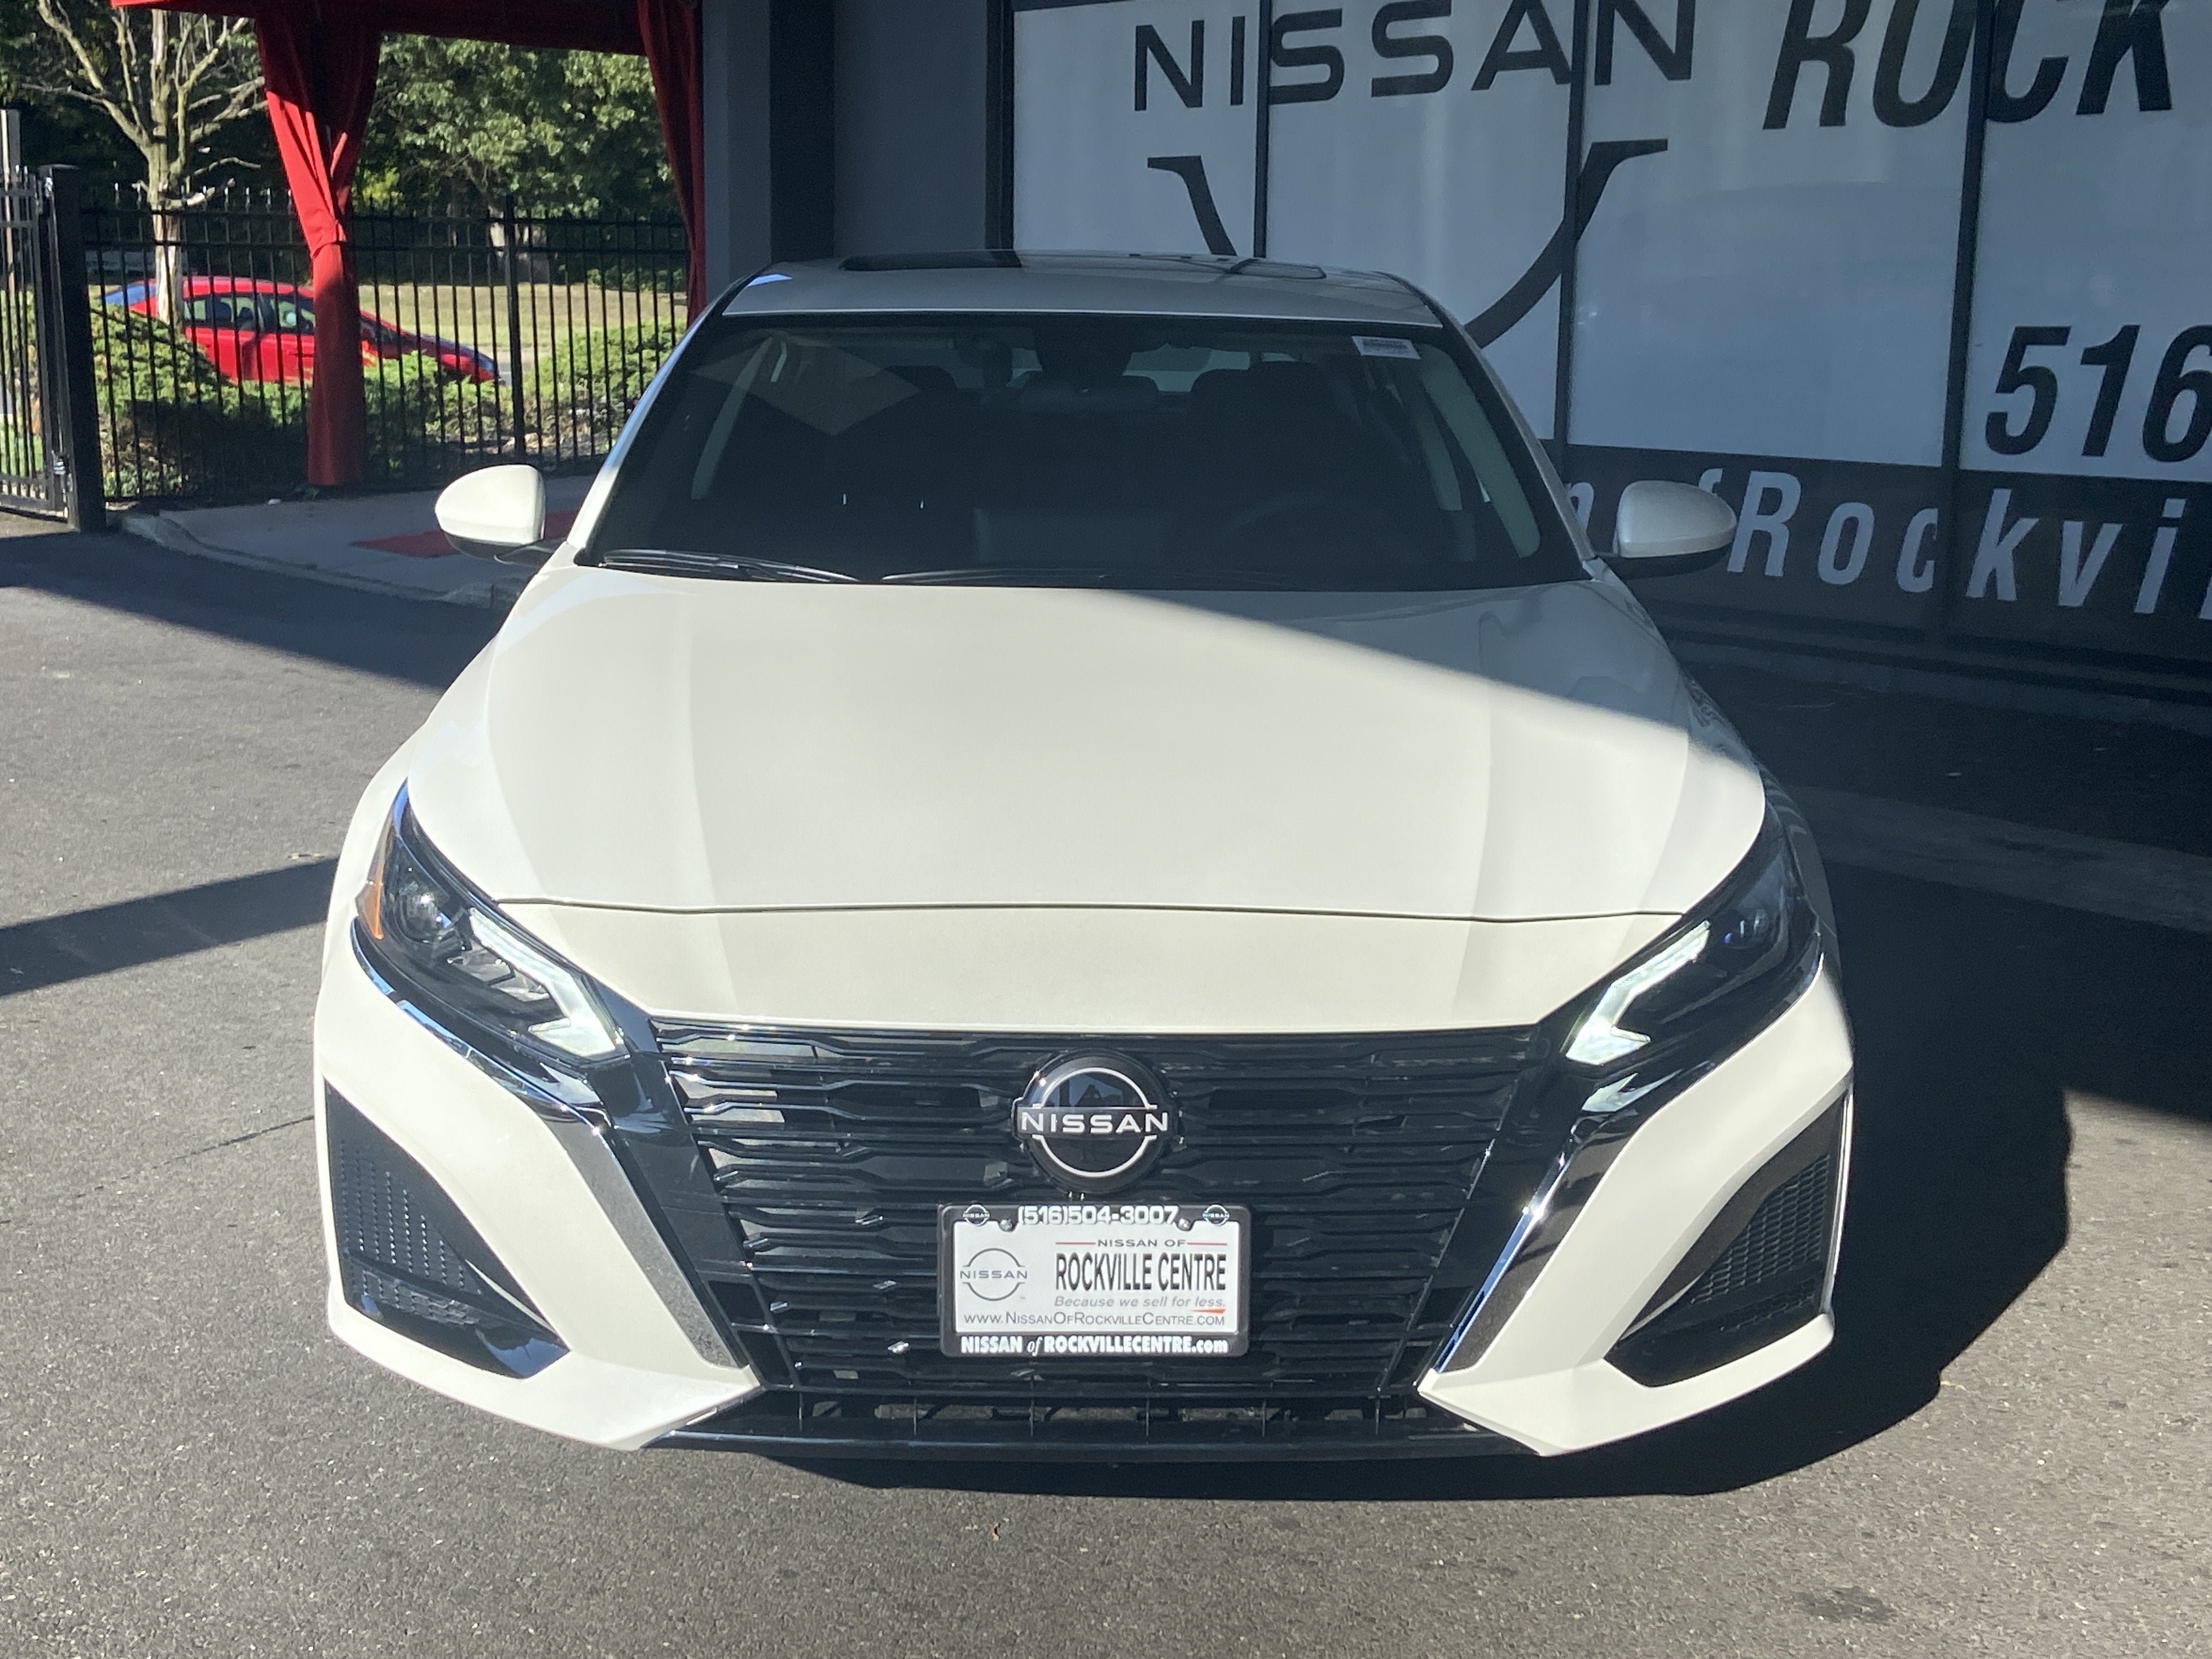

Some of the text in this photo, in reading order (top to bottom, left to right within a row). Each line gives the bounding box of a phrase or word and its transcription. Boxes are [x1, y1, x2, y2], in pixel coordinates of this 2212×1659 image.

[1135, 0, 1697, 111] NISSAN
[1021, 1112, 1169, 1134] NISSAN
[1018, 1205, 1179, 1224] (516)504-3007
[1097, 1239, 1186, 1247] NISSAN OF
[960, 1270, 1028, 1279] NISSAN
[1055, 1252, 1227, 1291] ROCKVILLE CENTRE
[1054, 1296, 1115, 1307] Because
[1119, 1298, 1139, 1307] we
[1143, 1296, 1168, 1307] sell
[1171, 1296, 1191, 1307] for
[961, 1335, 1228, 1357] NISSAN of ROCKVILLECENTRE.com
